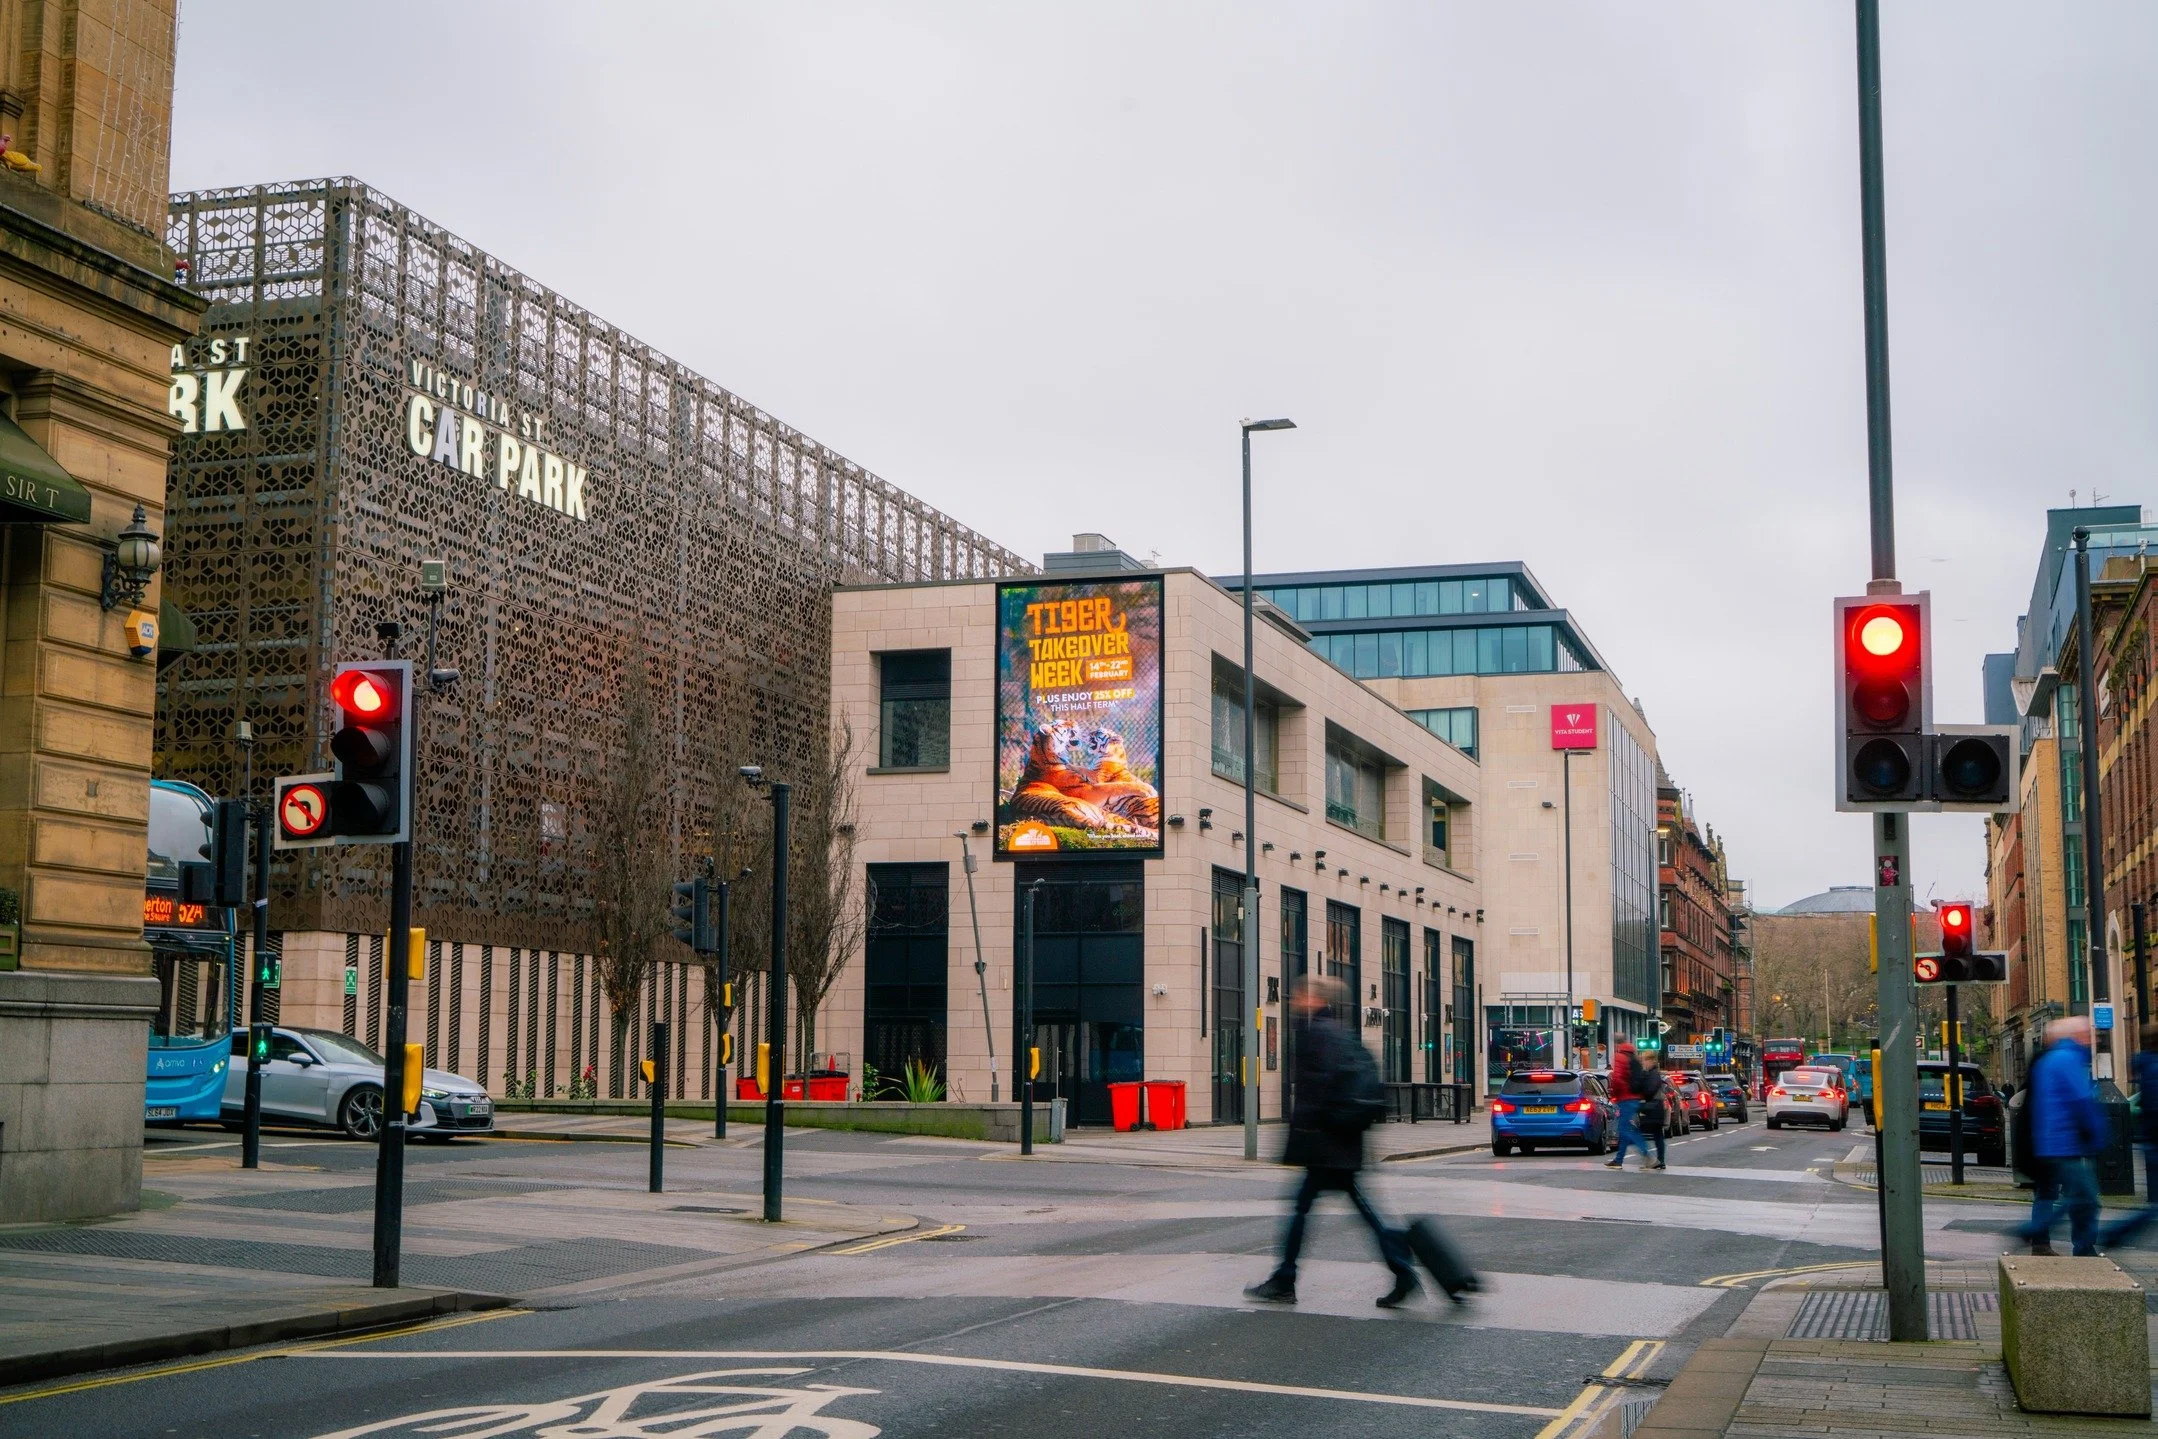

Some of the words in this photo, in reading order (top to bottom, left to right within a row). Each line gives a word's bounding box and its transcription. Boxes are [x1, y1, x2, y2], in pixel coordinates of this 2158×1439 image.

[210, 337, 249, 364] ST
[412, 360, 510, 431] VICTORIA
[522, 412, 543, 441] ST
[409, 395, 484, 479] CAR
[499, 433, 587, 522] PARK
[6, 475, 38, 503] SIR
[45, 487, 59, 508] T
[1027, 597, 1127, 635] TIGER
[1029, 632, 1129, 661] TAKEOVER
[1030, 659, 1084, 689] WEEK
[1090, 671, 1128, 679] FEBRUARY
[1036, 693, 1060, 703] PLUS
[1062, 692, 1092, 702] ENJOY
[1095, 690, 1111, 699] 25%
[1113, 689, 1133, 698] OFF
[1051, 704, 1069, 712] THIS
[1070, 702, 1091, 710] HALF
